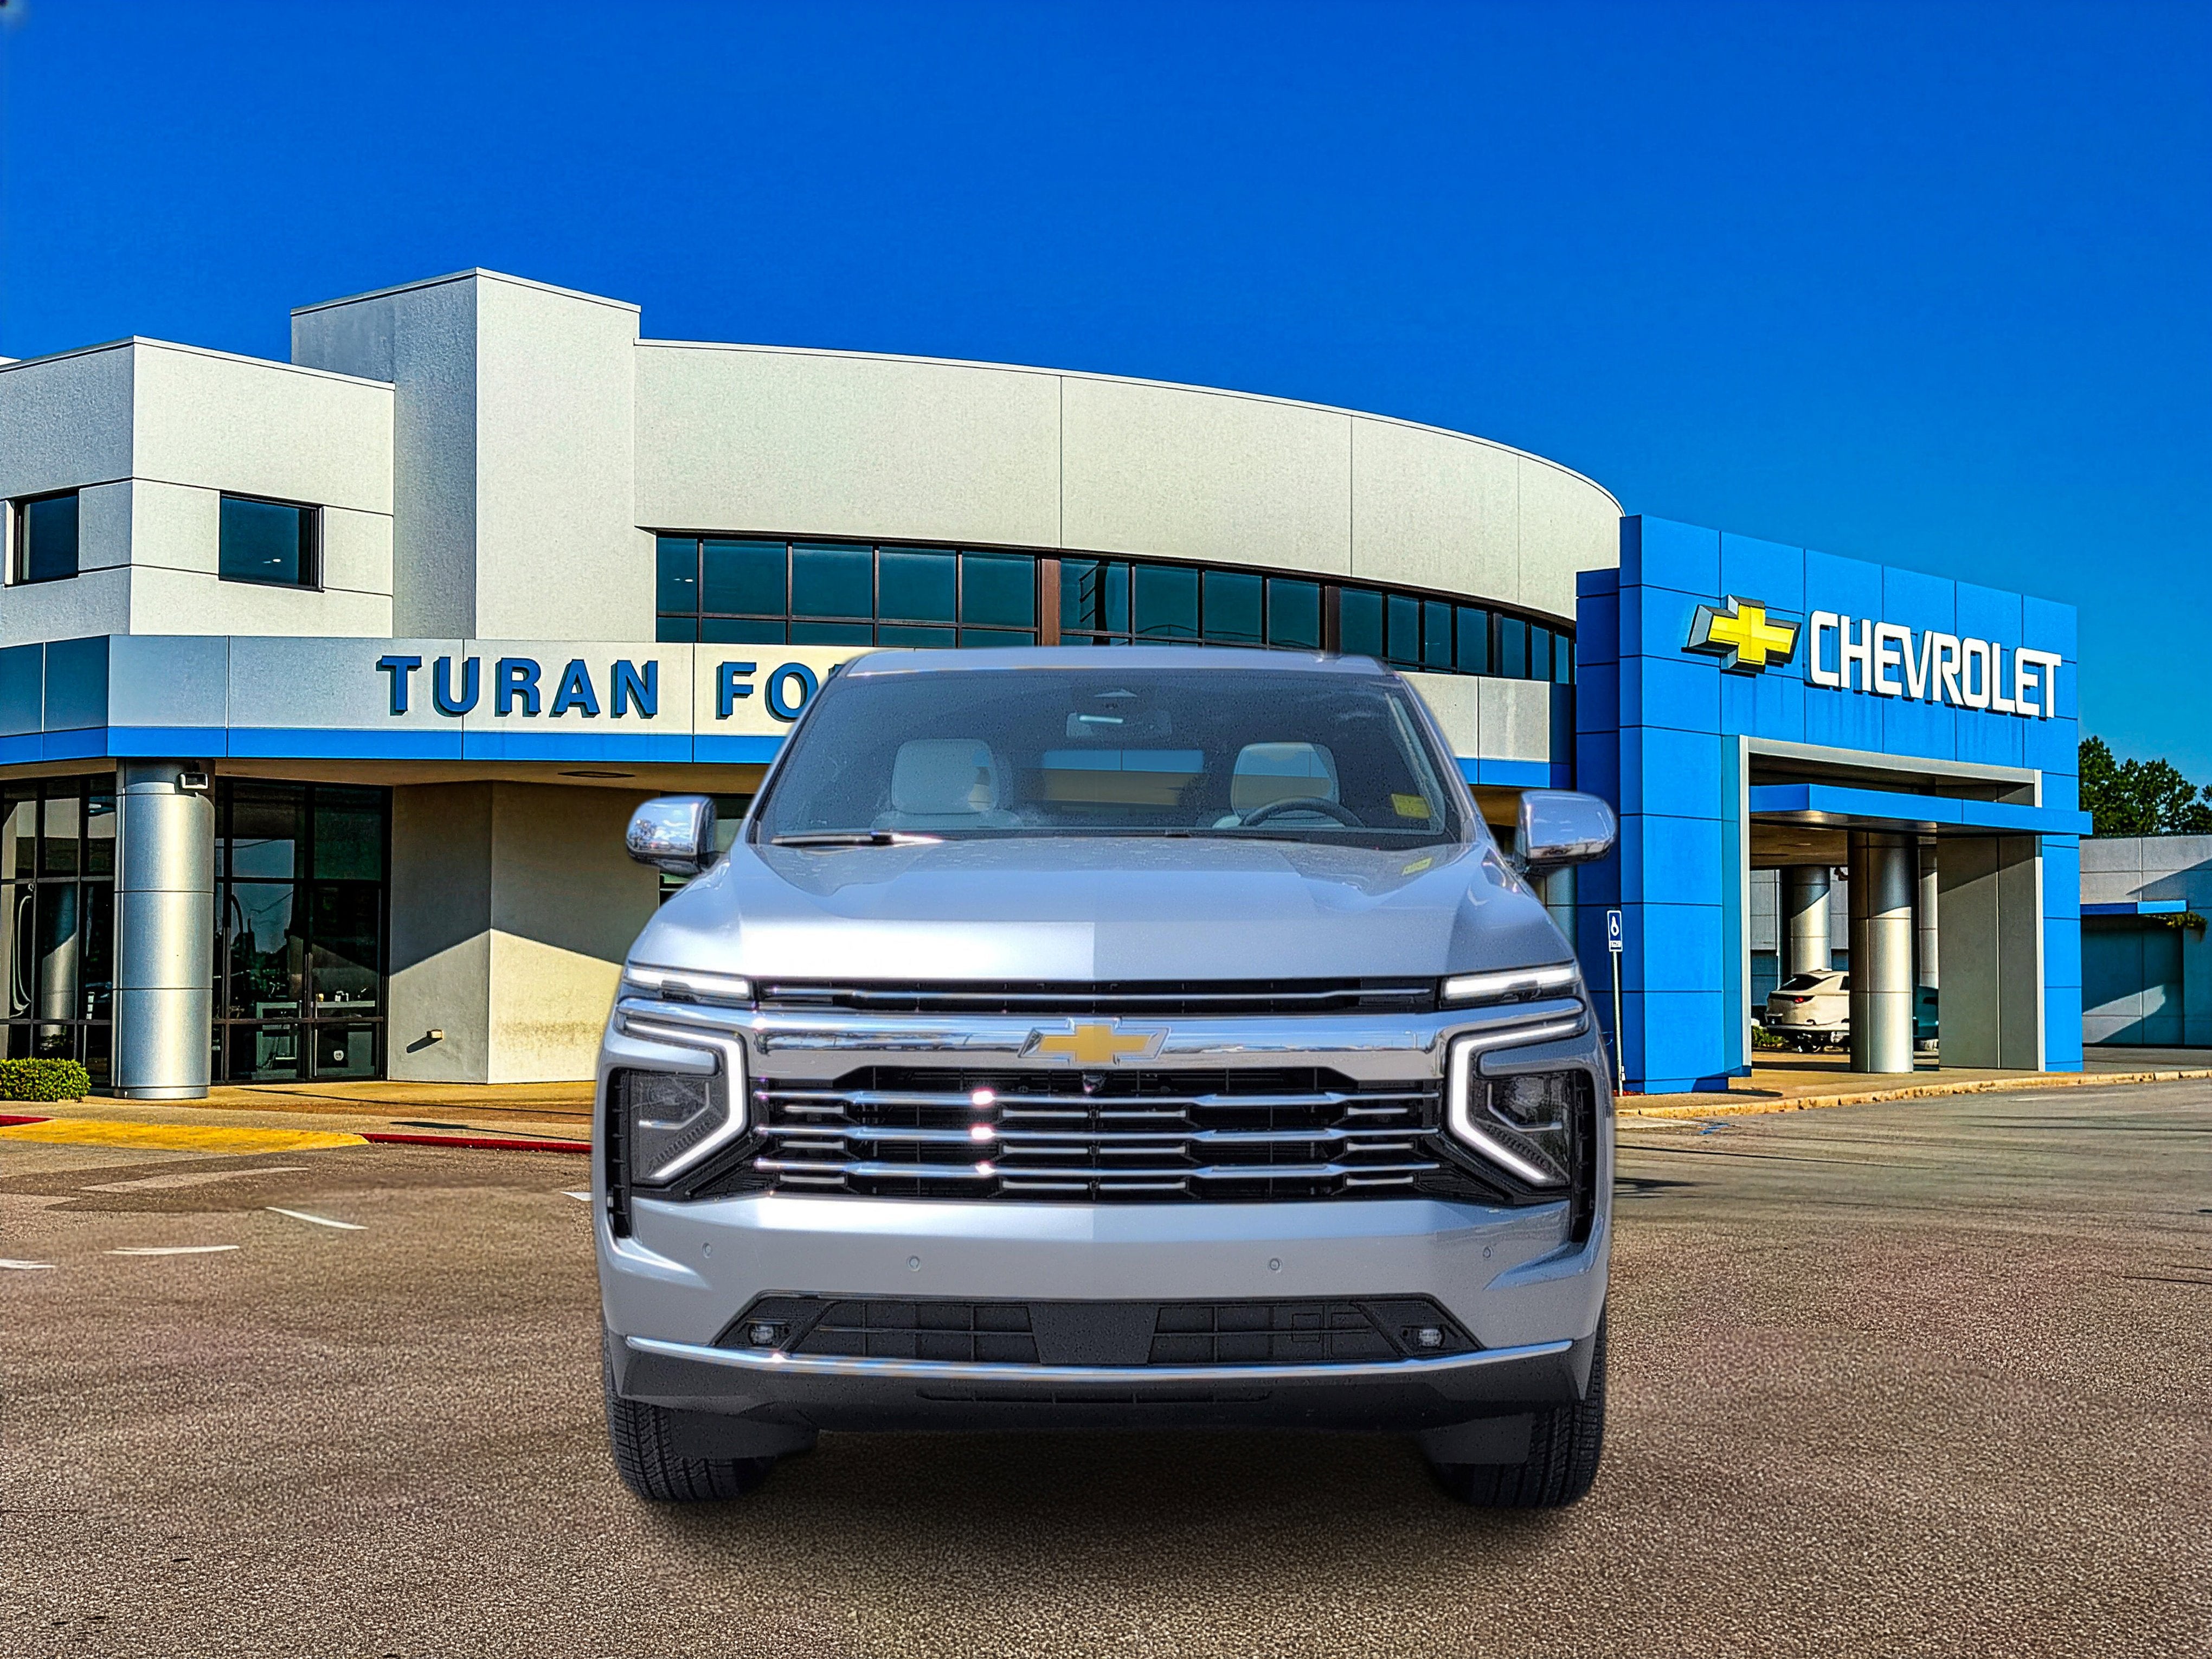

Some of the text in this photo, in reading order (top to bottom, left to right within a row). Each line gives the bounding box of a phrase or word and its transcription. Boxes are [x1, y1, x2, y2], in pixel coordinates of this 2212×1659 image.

[376, 655, 844, 723] TURAN FO
[1810, 610, 2062, 719] CHEVROLET
